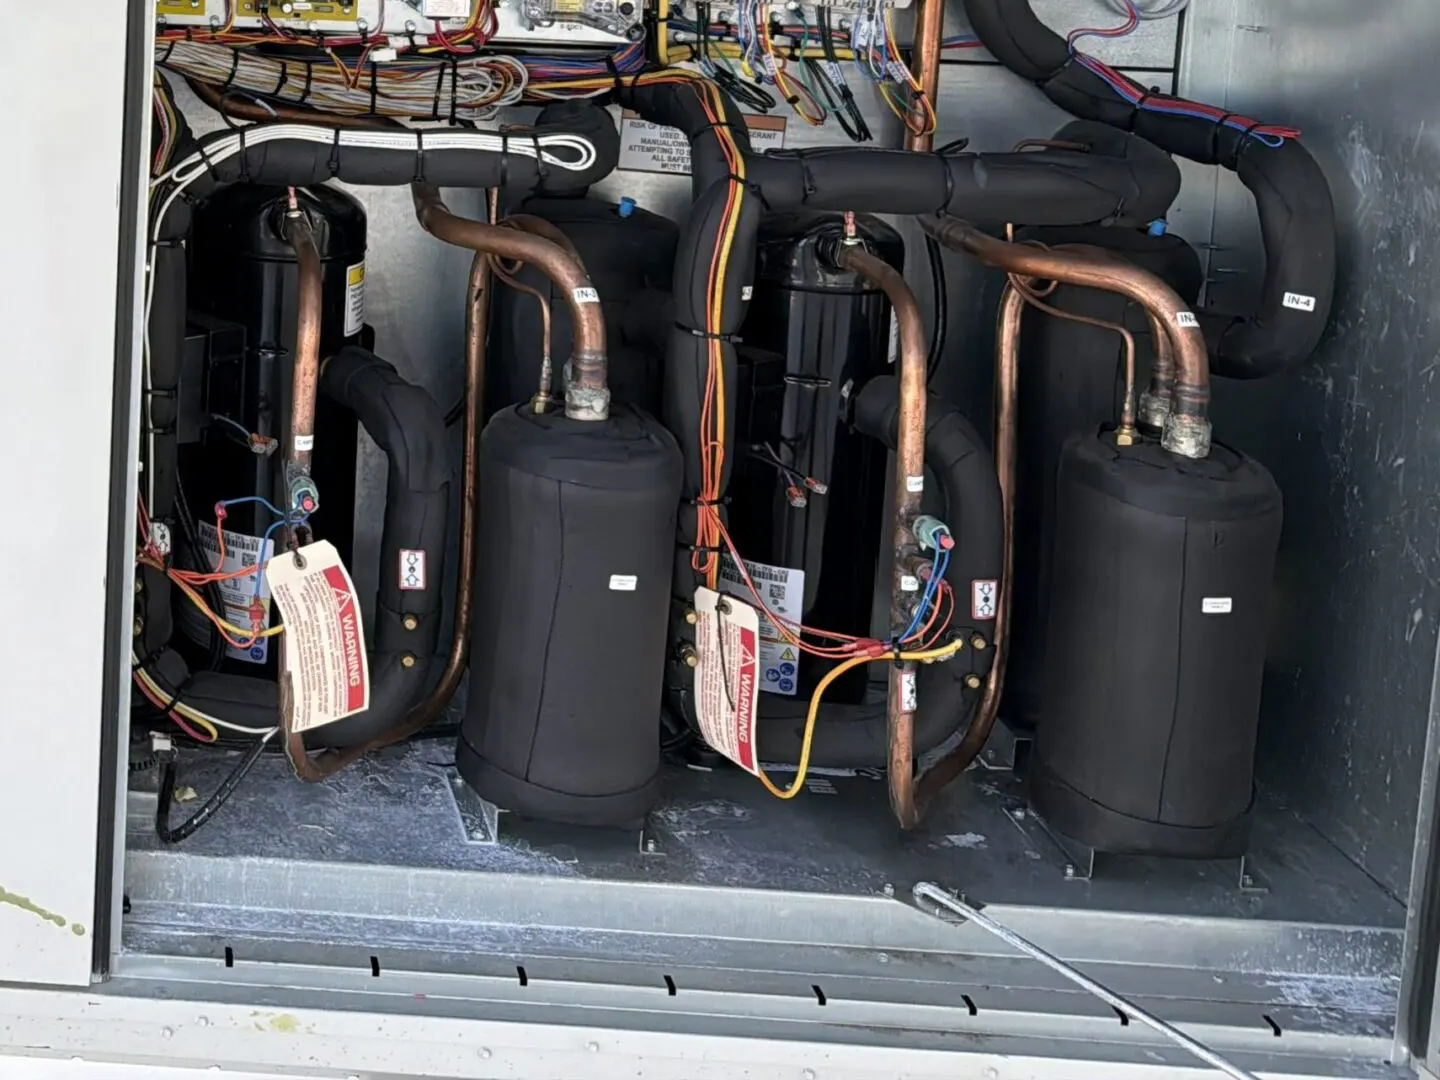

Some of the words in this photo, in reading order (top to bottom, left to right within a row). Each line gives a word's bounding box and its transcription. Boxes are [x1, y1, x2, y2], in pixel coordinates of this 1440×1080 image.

[628, 145, 674, 156] ATTEMPTING
[676, 148, 684, 156] TO
[667, 155, 691, 163] SAFET
[661, 163, 679, 171] MUST
[1288, 295, 1311, 307] IN-4
[342, 615, 360, 686] WARNING
[739, 674, 752, 743] WARNING
